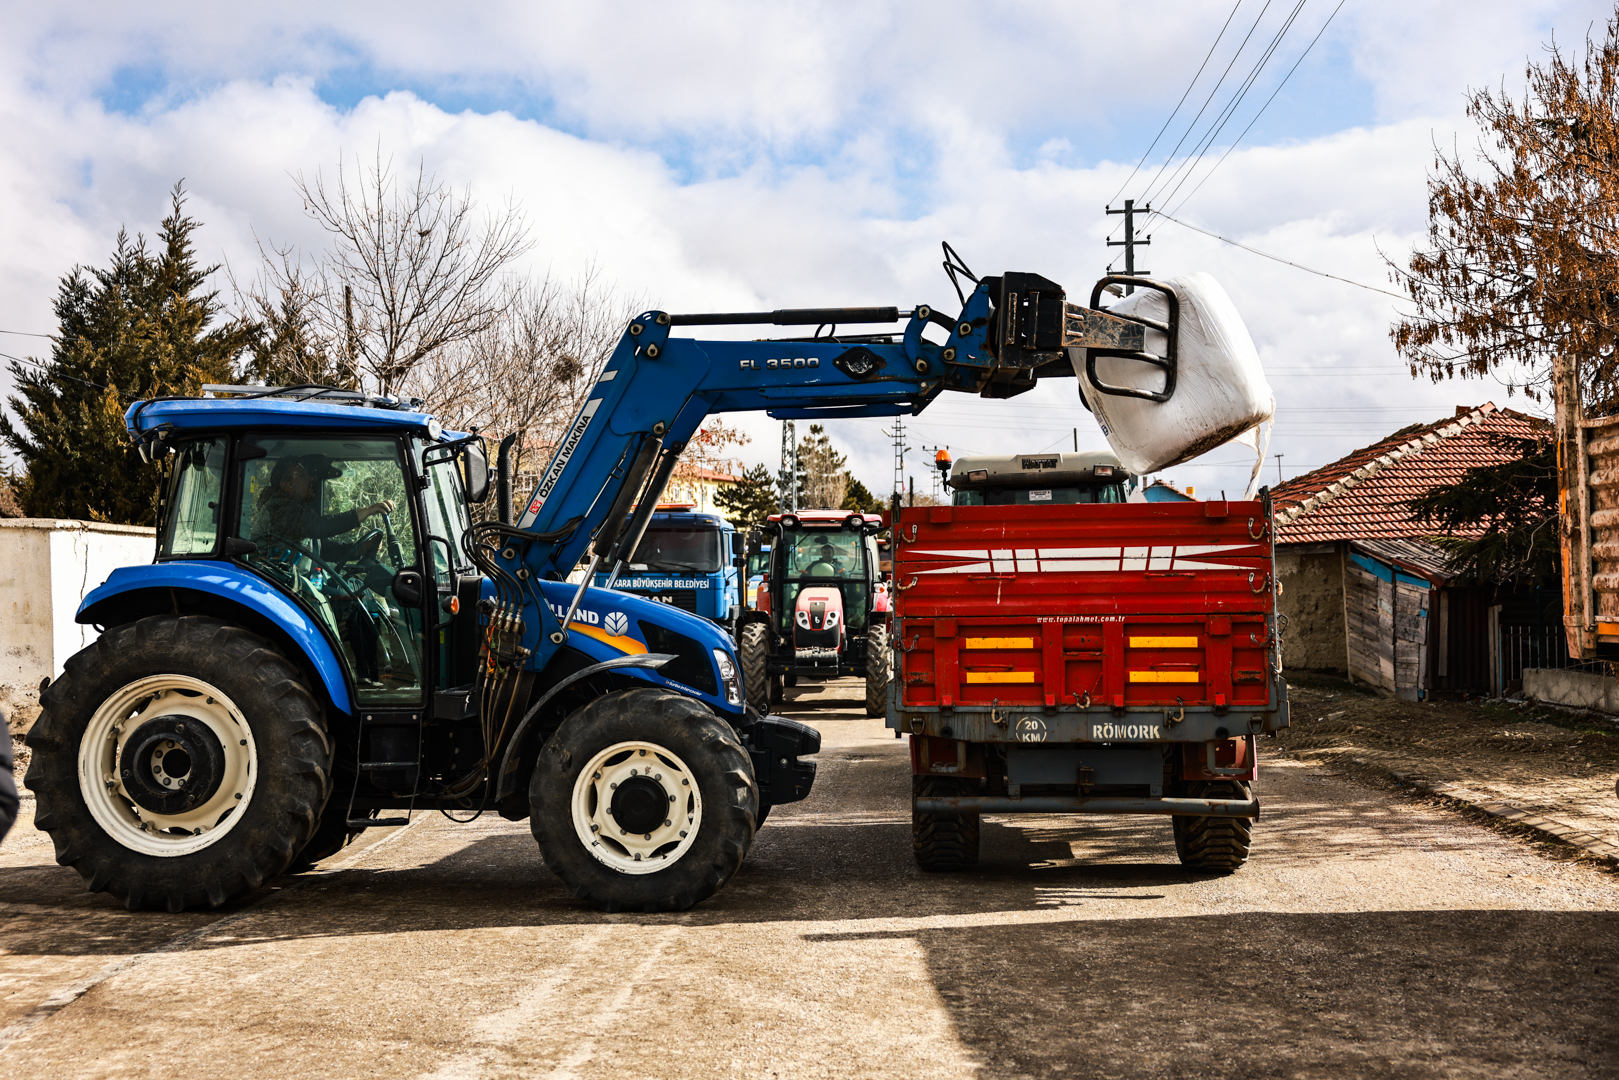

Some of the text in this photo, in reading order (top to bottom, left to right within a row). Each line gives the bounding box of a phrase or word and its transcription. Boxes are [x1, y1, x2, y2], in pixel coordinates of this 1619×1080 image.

[739, 357, 820, 371] FL 3500
[539, 415, 591, 498] ÖZKAN MAKİNA
[604, 577, 710, 589] KARA BÜYÜKŞEHİR BELEDİYESİ
[645, 595, 673, 604] AN
[1036, 615, 1126, 624] www.topalahmet.com.tr
[1024, 720, 1039, 731] 20
[1092, 722, 1161, 739] RÖMORK
[1022, 733, 1041, 743] KM
